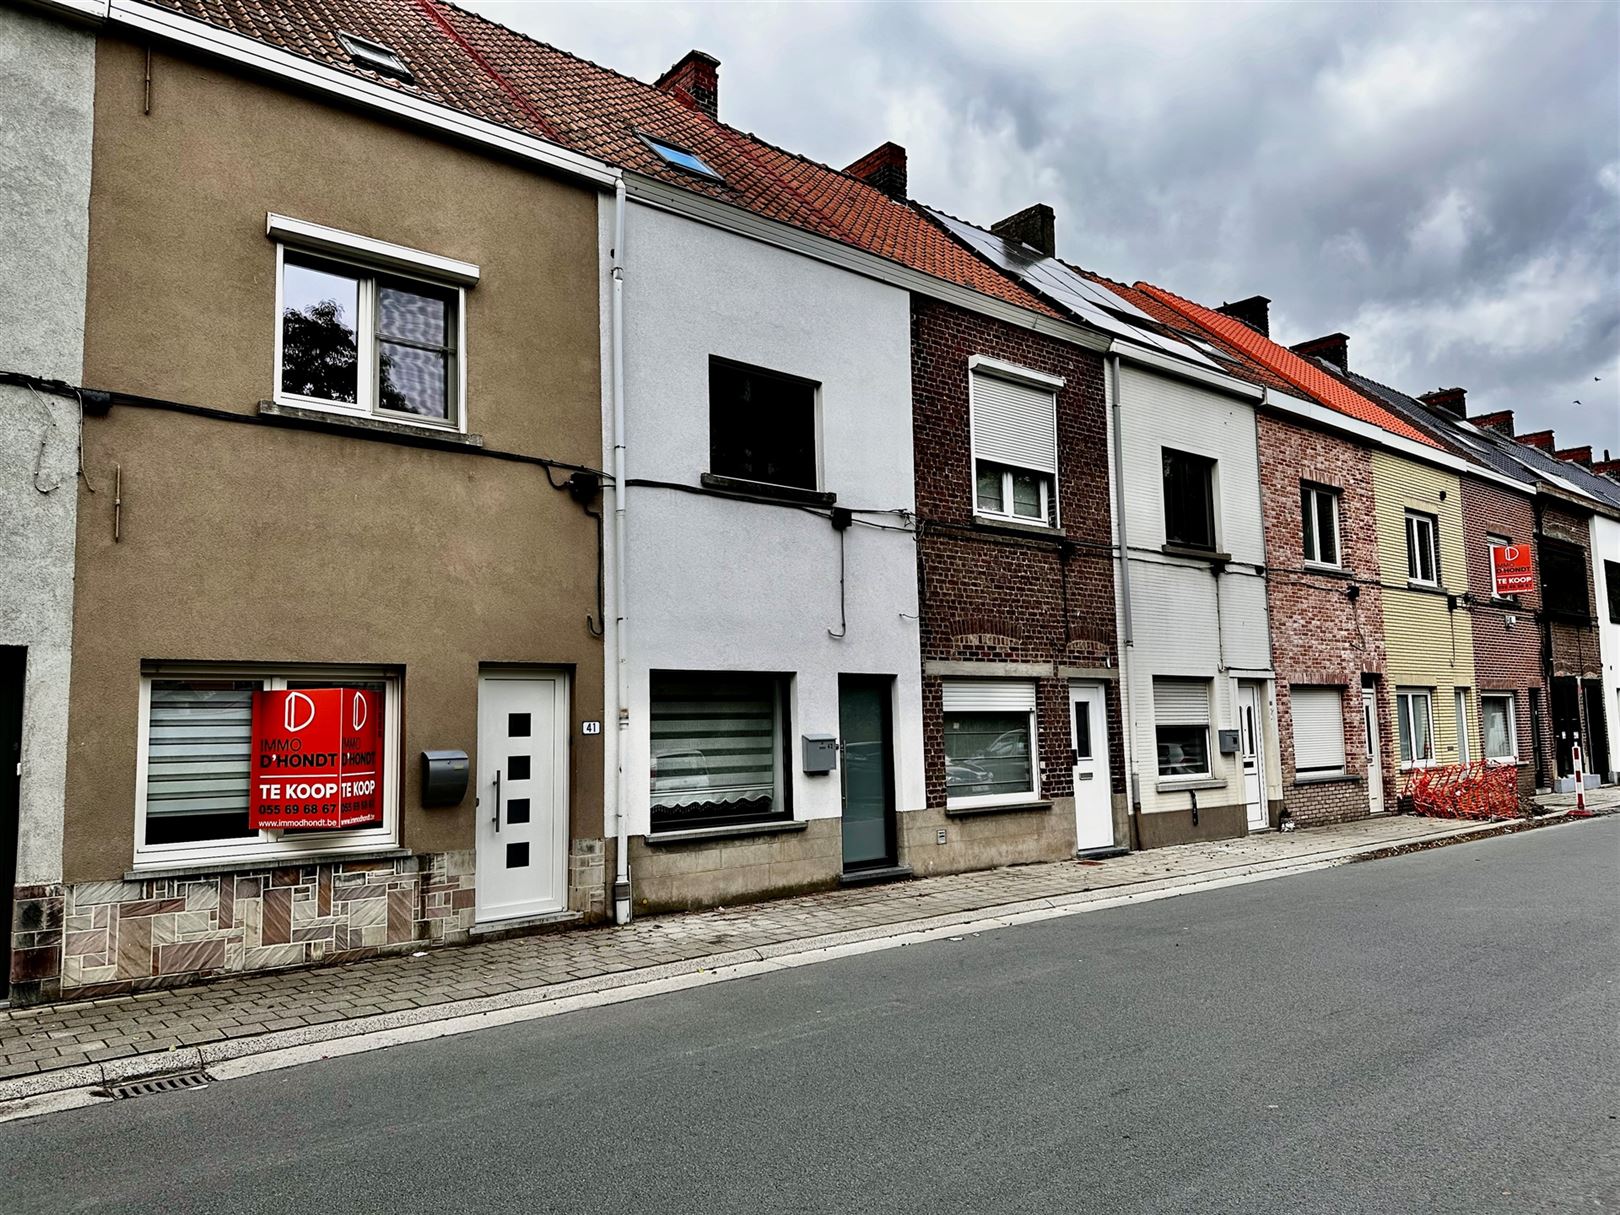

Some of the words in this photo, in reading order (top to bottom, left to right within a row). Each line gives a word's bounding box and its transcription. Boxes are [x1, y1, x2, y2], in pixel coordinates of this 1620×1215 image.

[1509, 576, 1532, 584] KOOP
[586, 722, 596, 733] 41
[260, 738, 302, 752] IMMO
[260, 753, 338, 769] D'HONDT
[260, 784, 281, 800] TE
[286, 783, 338, 799] KOOP
[341, 782, 352, 798] TE
[353, 779, 376, 797] KOOP
[259, 804, 281, 815] 055
[284, 804, 300, 815] 69
[303, 804, 318, 814] 68
[322, 803, 337, 814] 67
[259, 818, 337, 828] www.immodhondt.be
